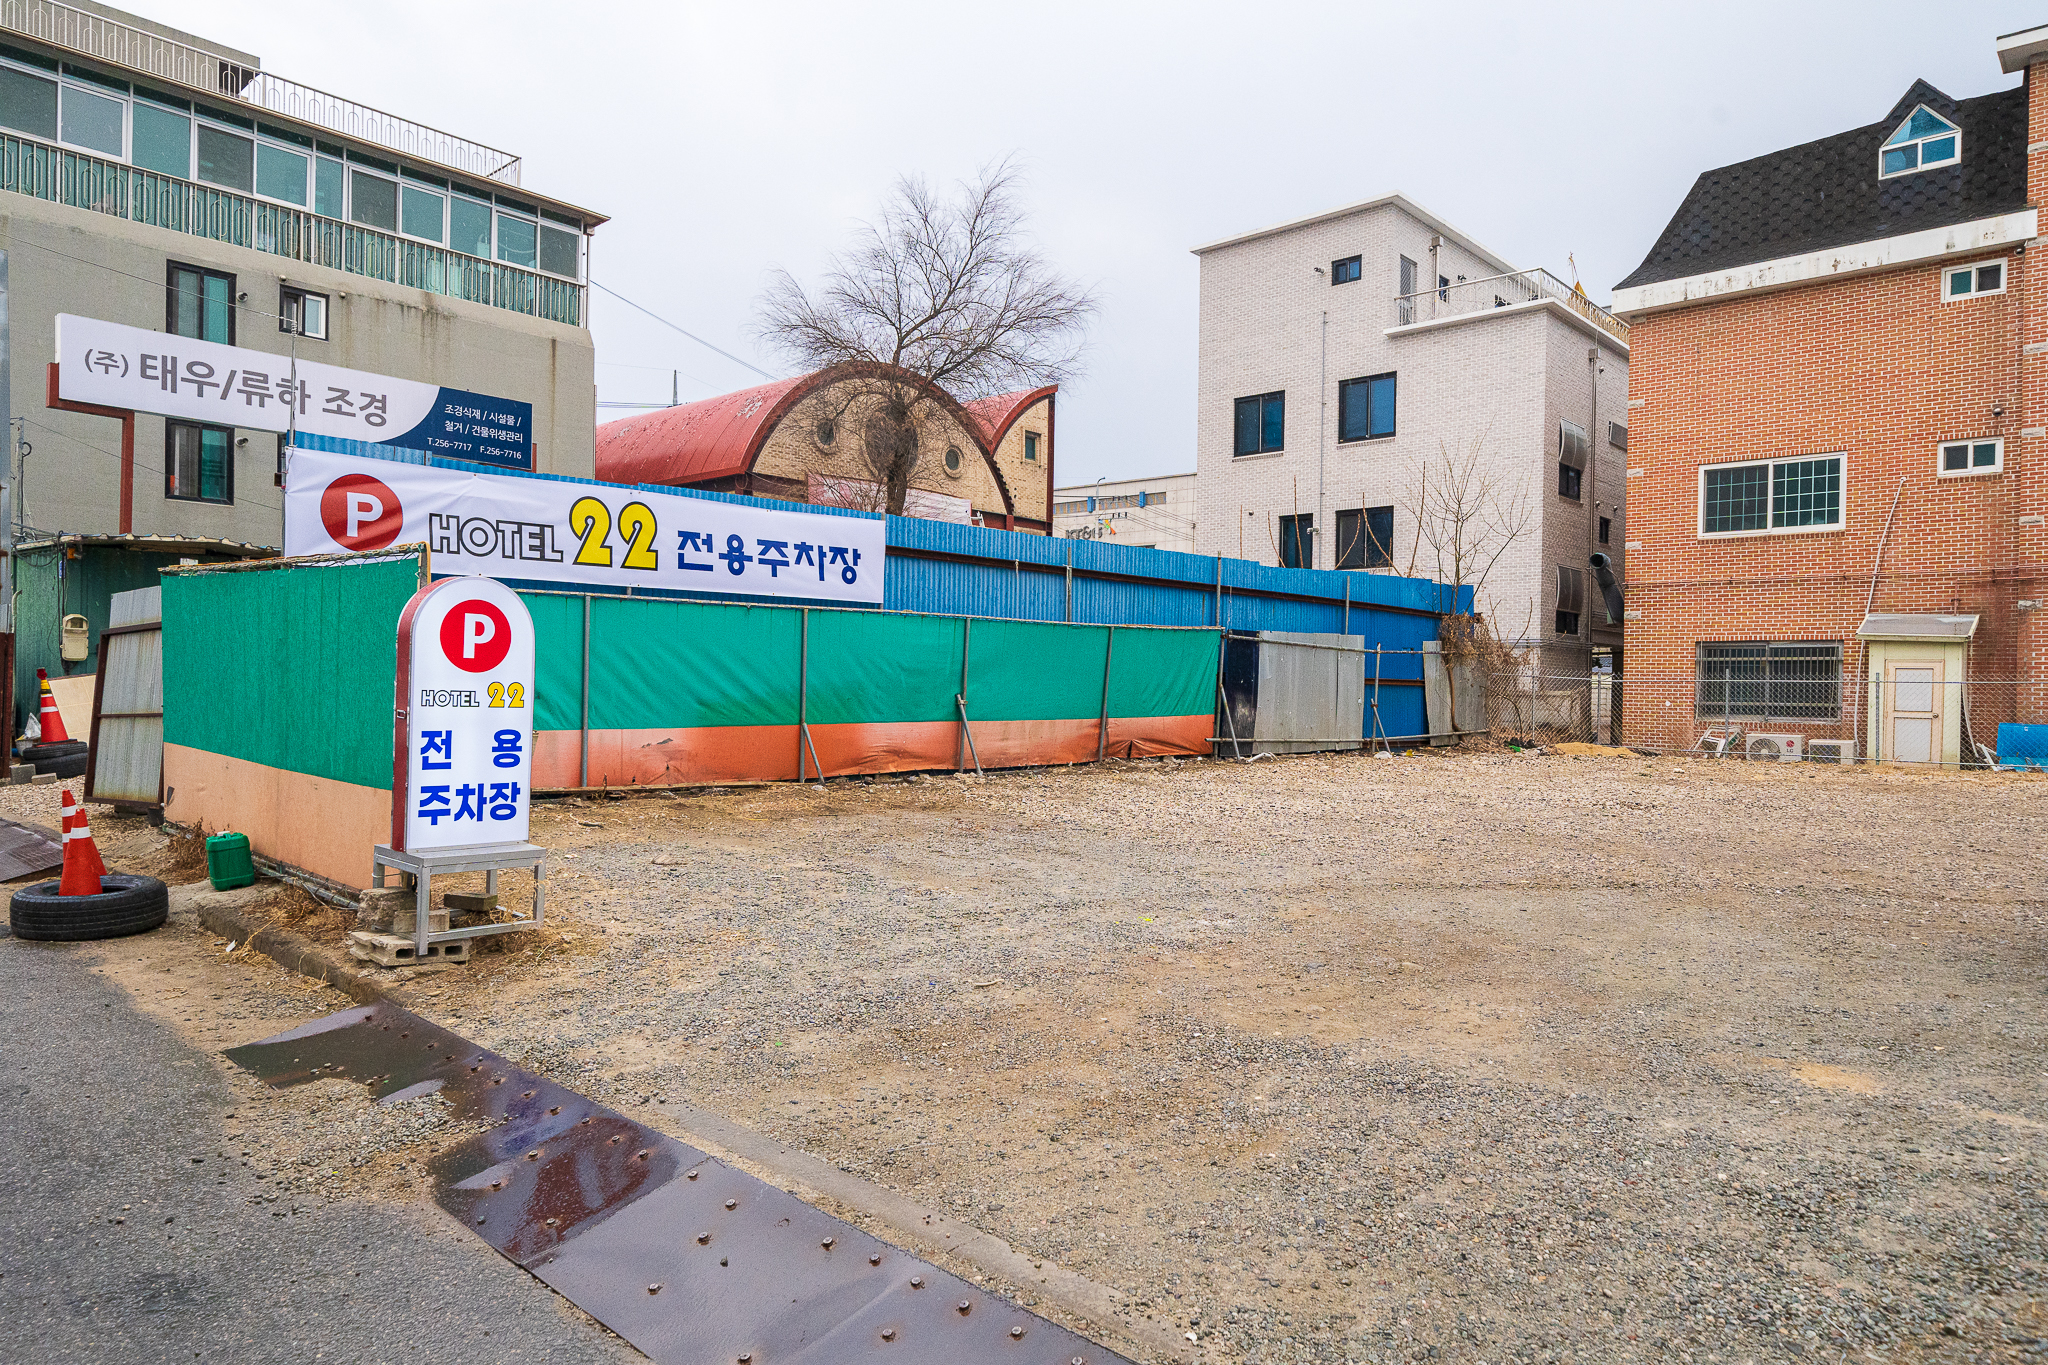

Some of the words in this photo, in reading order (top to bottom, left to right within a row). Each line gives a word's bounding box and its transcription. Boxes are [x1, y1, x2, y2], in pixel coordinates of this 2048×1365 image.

[84, 348, 130, 378] (주)
[140, 353, 312, 415] 태우/류하
[322, 386, 388, 428] 조경
[444, 404, 481, 420] 조경식재
[489, 412, 515, 426] 시설물
[444, 420, 463, 433] 철거
[471, 425, 523, 443] 건물위생관리
[427, 437, 472, 451] T.256-7717
[479, 445, 522, 459] F.256-7716
[346, 491, 384, 537] P
[429, 512, 564, 563] HOTEL
[568, 495, 658, 571] 22
[677, 530, 862, 585] 전용주차장
[463, 612, 496, 659] P
[421, 689, 480, 708] HOTEL
[487, 681, 525, 708] 22
[417, 781, 521, 826] 주차장
